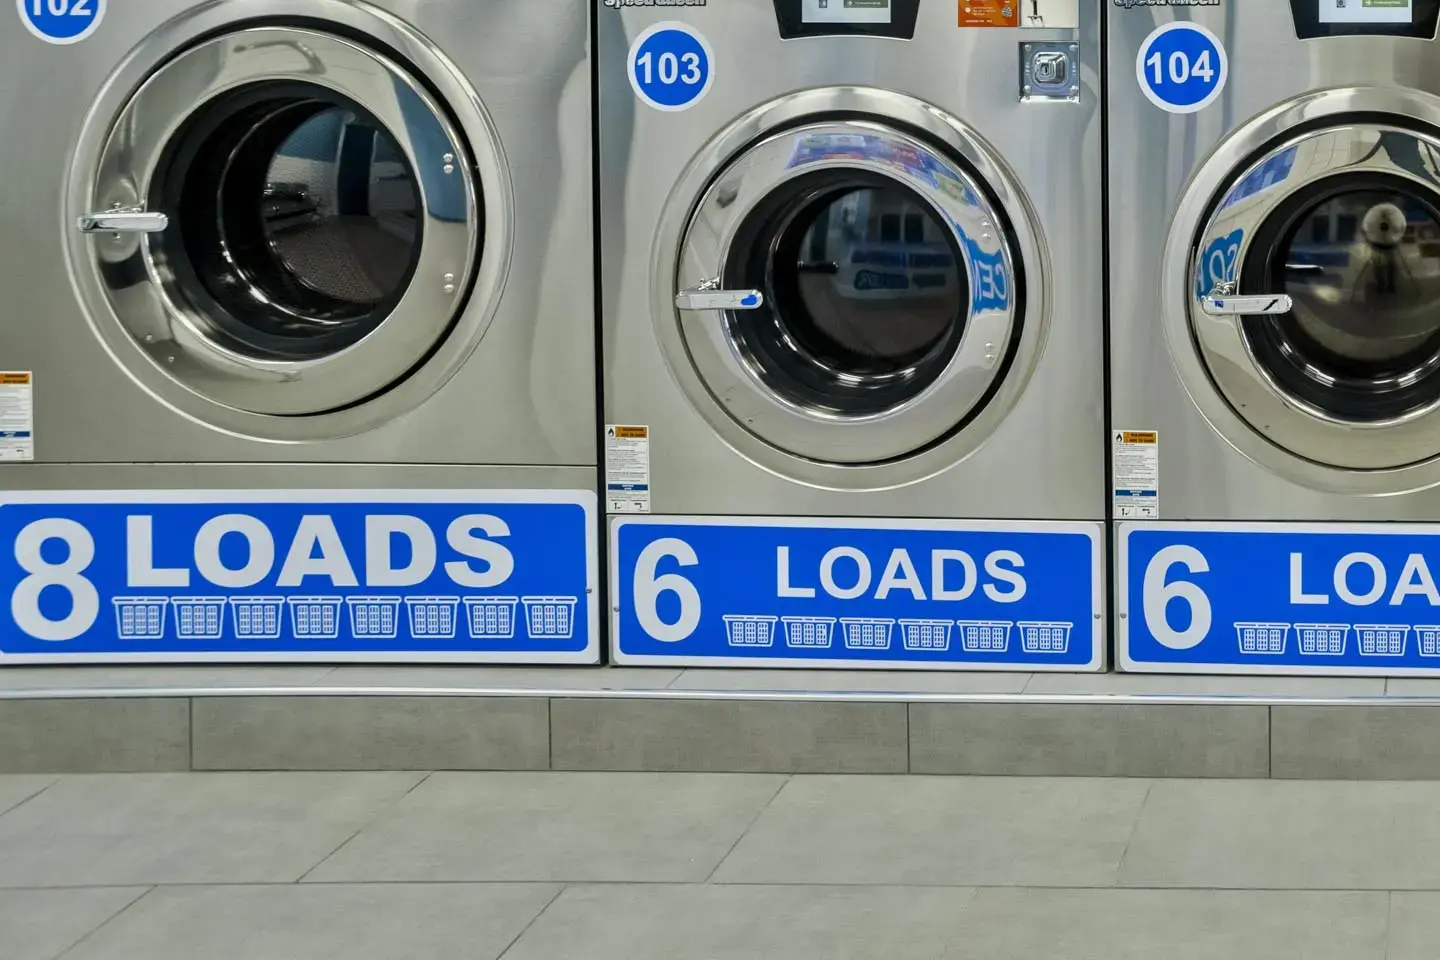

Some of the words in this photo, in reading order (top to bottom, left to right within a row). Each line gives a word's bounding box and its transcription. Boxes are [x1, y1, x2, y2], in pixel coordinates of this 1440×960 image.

[637, 52, 701, 85] 103
[1146, 50, 1214, 84] 104
[11, 517, 99, 641] 8
[126, 514, 514, 588] LOADS
[633, 537, 701, 642] 6
[776, 546, 1027, 603] LOADS
[1142, 544, 1212, 650] 6
